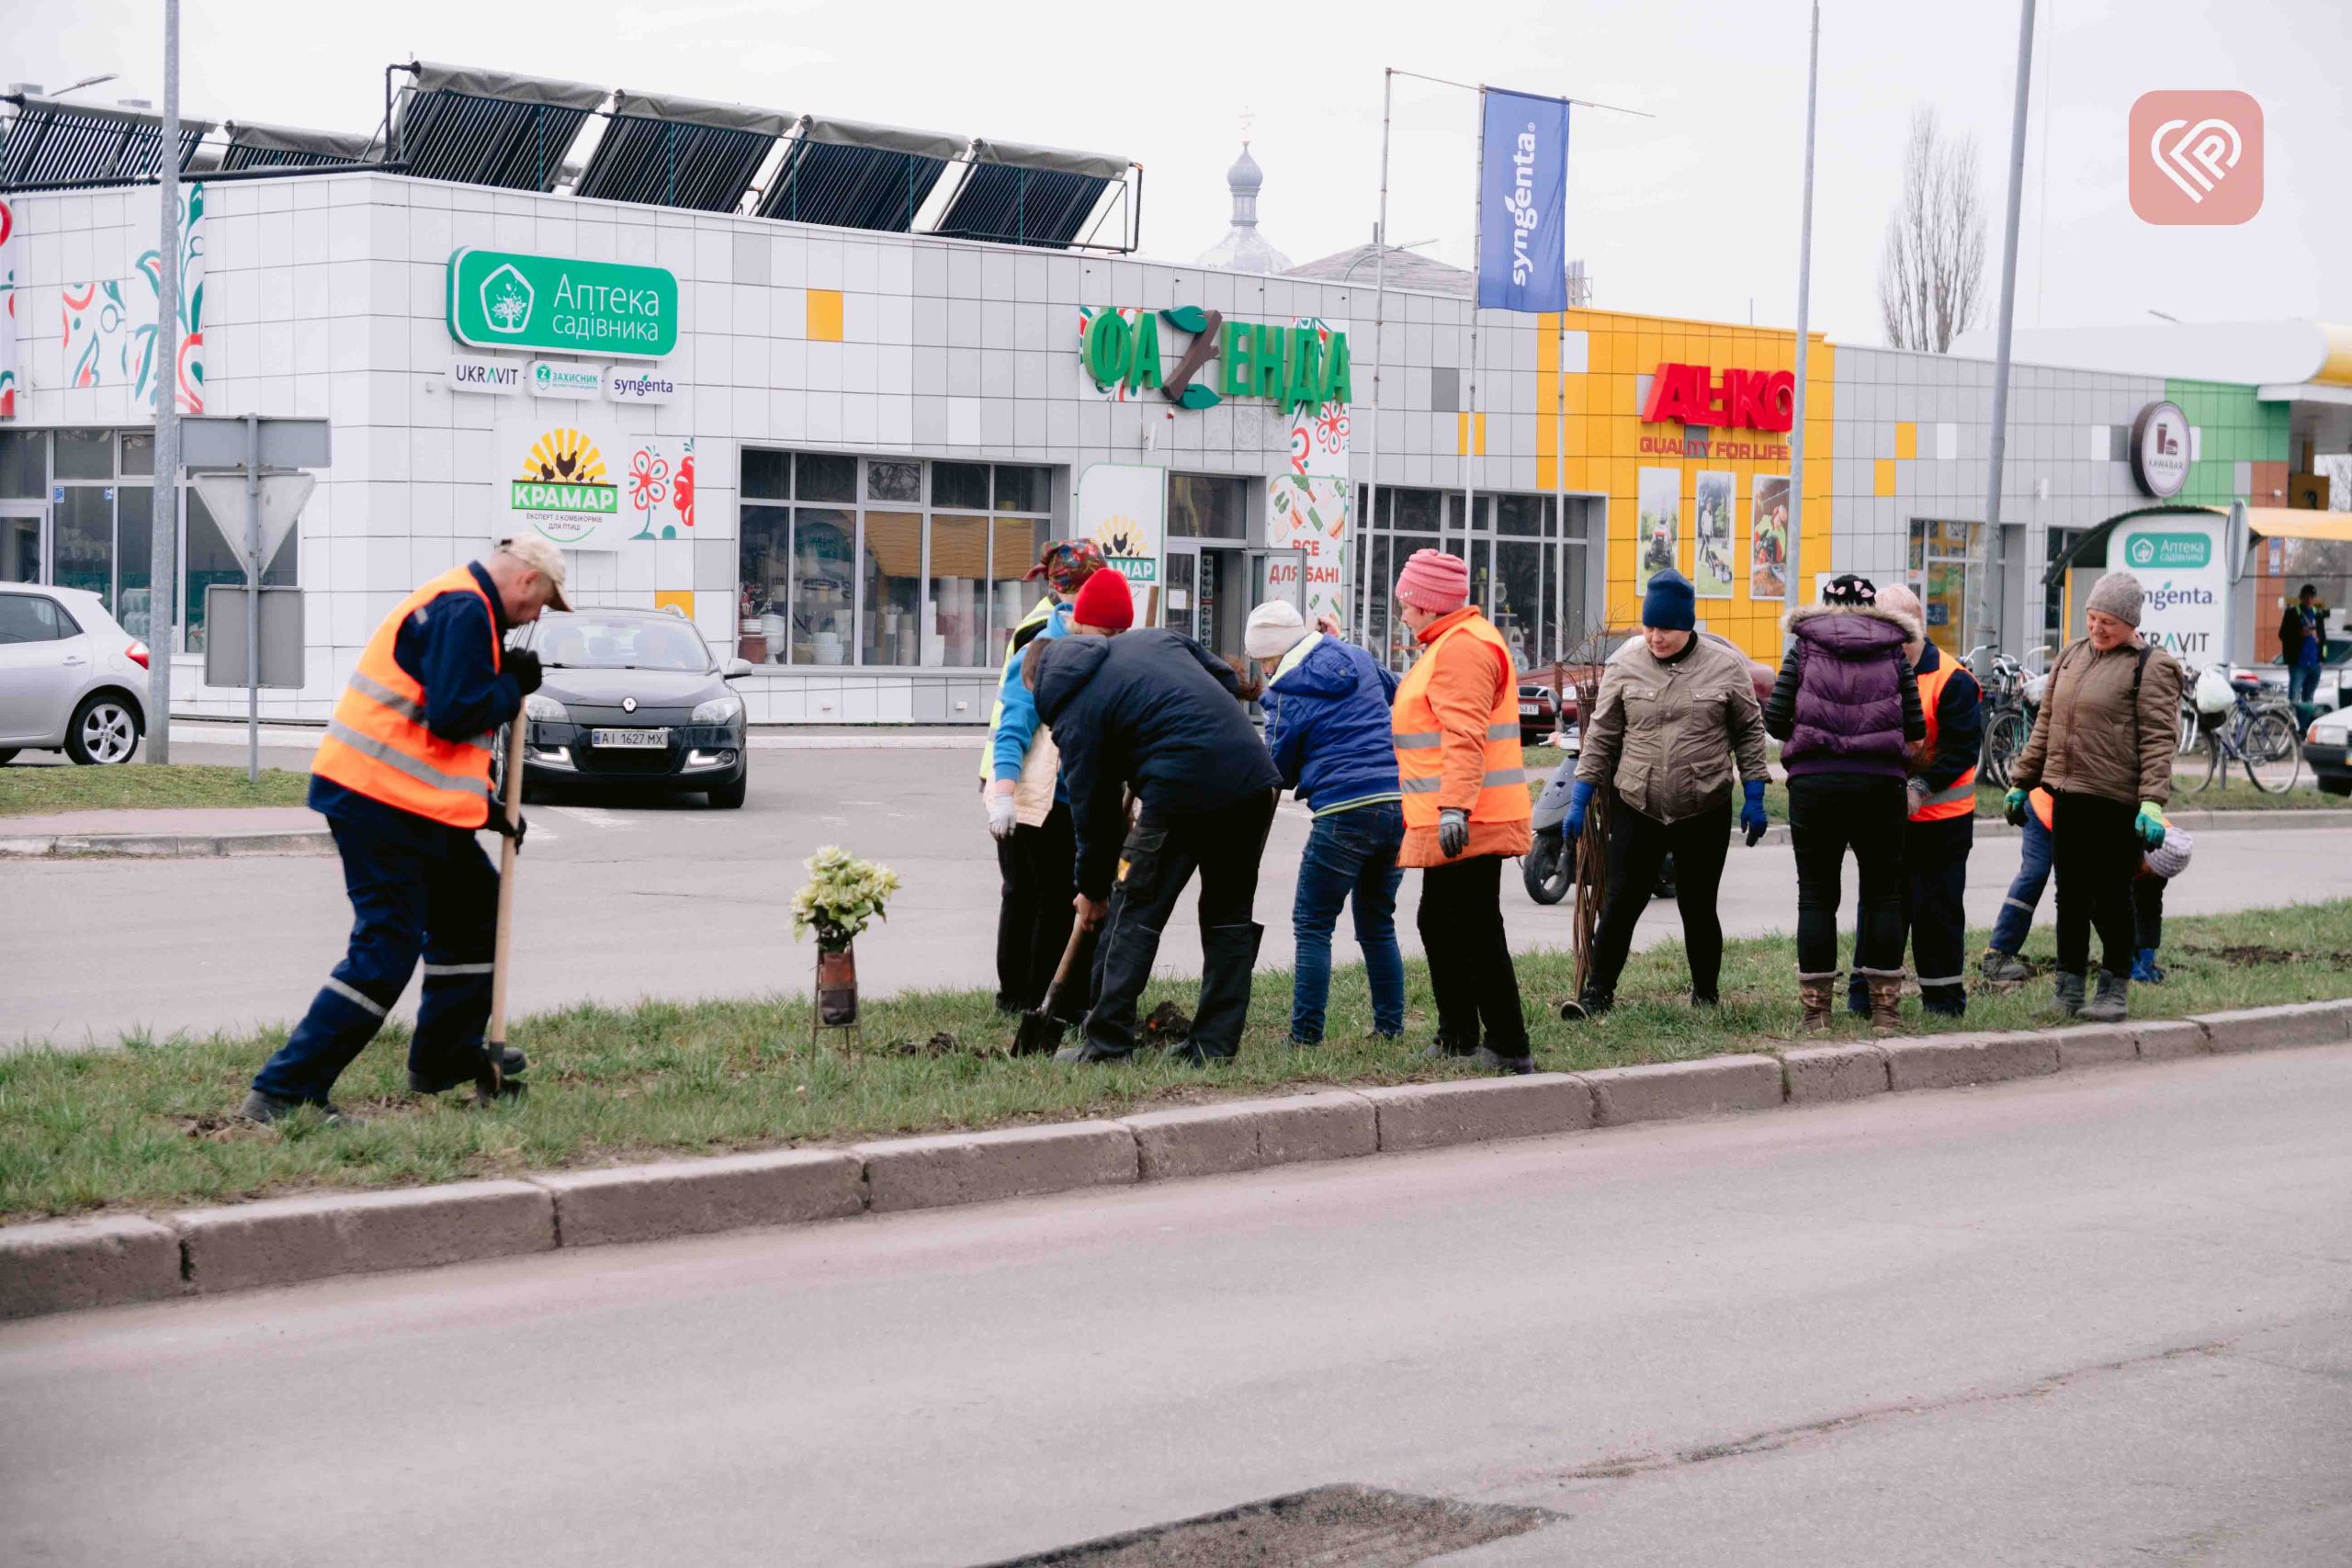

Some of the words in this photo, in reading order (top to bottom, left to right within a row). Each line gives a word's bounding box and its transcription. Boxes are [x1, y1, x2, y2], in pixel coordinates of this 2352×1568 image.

[553, 273, 660, 317] Аптека
[552, 312, 659, 342] садівника
[456, 365, 518, 386] UKRAVIT
[552, 372, 598, 383] ЗАХИСНИК
[614, 378, 673, 396] syngenta
[1639, 436, 1713, 457] QUALITY
[1716, 442, 1751, 459] FOR
[1755, 444, 1788, 459] LIFE
[514, 485, 615, 510] КРАМАР
[526, 513, 553, 521] ЕКСПЕРТ
[2161, 539, 2204, 552] Аптека
[1306, 566, 1339, 583] БАНІ
[602, 733, 615, 744] AI
[621, 733, 645, 744] 1627
[648, 734, 663, 745] MX
